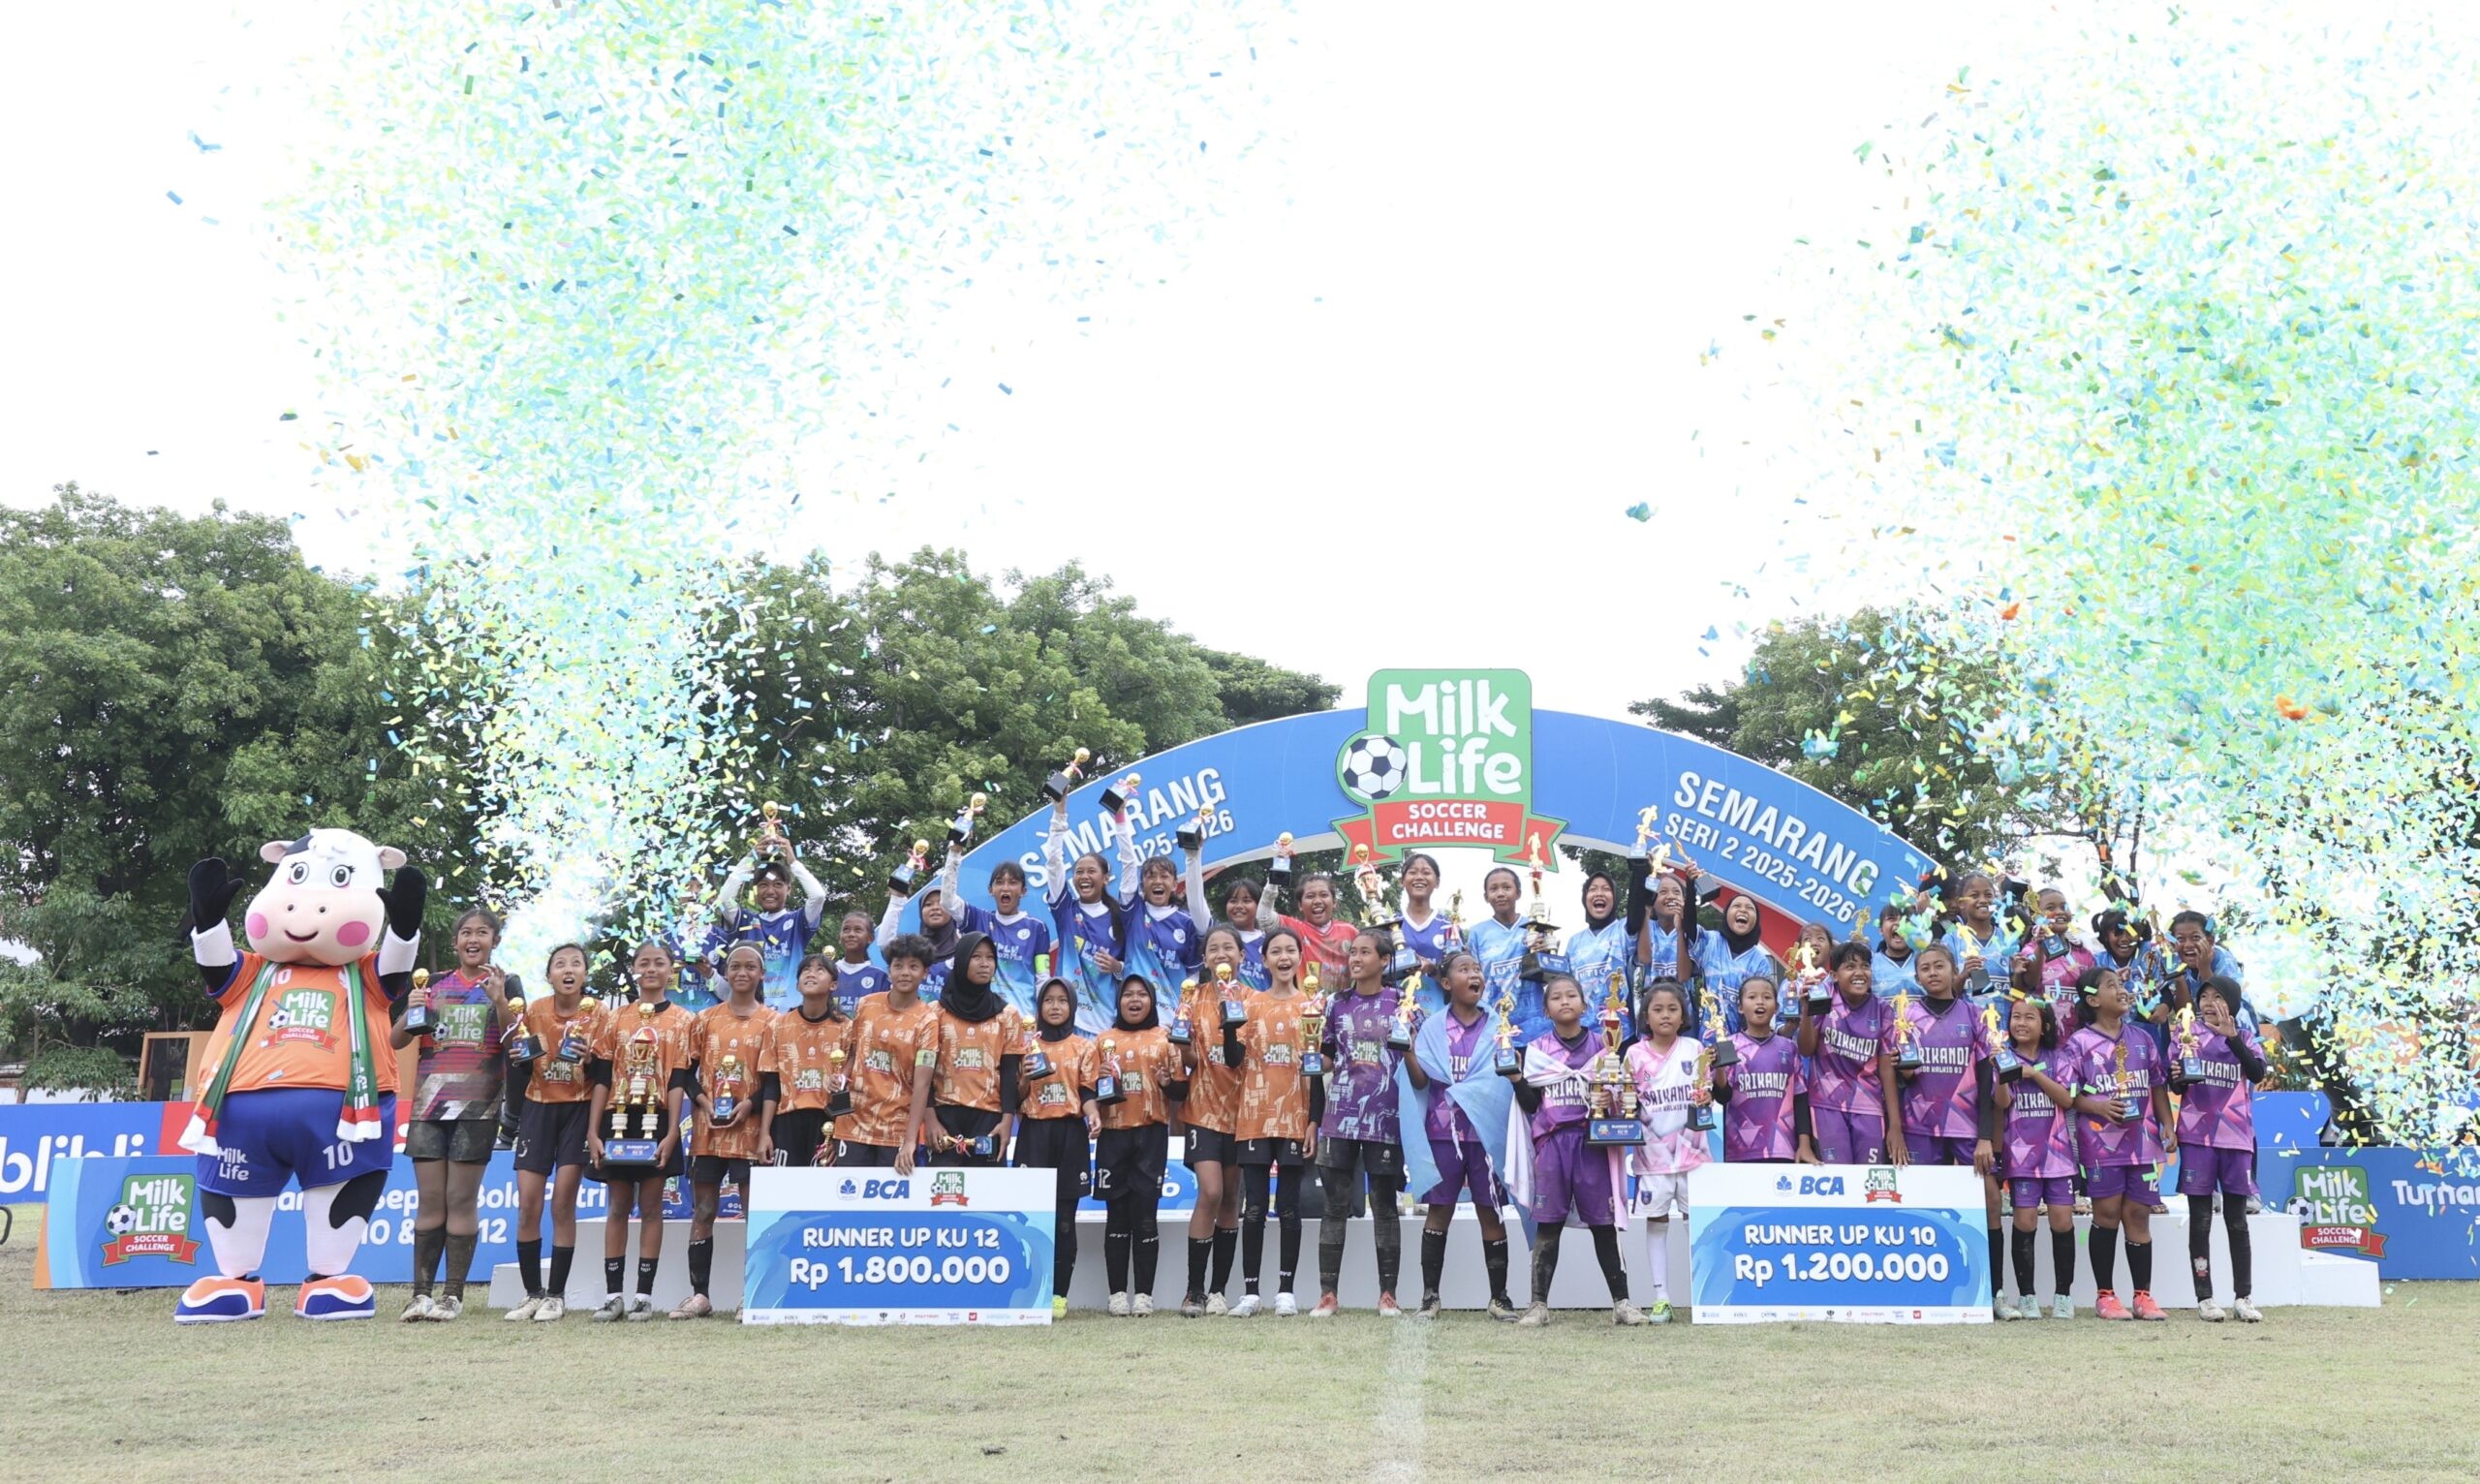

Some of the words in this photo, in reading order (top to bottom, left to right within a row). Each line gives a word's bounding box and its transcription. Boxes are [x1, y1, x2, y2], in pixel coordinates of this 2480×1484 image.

[1386, 679, 1517, 738] Milk
[1408, 737, 1522, 794] Life
[1409, 803, 1487, 819] SOCCER
[1392, 821, 1504, 840] CHALLENGE
[1673, 771, 1881, 899] SEMARANG
[1664, 812, 1721, 852] SERI
[1721, 837, 1741, 860] 2
[1741, 846, 1858, 924] 2025-2026
[285, 991, 328, 1011] Milk
[288, 1009, 328, 1028] Life
[444, 1007, 481, 1023] Milk
[281, 1033, 320, 1041] CHALLENGE
[449, 1023, 481, 1039] Life
[1270, 1044, 1289, 1054] Milk
[1357, 1042, 1377, 1052] Milk
[1823, 1027, 1878, 1057] SRIKANDI
[872, 1050, 890, 1063] Milk
[960, 1049, 981, 1060] Milk
[962, 1058, 981, 1067] Life
[1272, 1053, 1290, 1063] Life
[1358, 1051, 1378, 1062] Life
[1918, 1047, 1969, 1067] RIKANDI
[801, 1069, 822, 1080] Milk
[873, 1060, 890, 1071] Life
[2201, 1060, 2242, 1081] IKANDI
[805, 1079, 822, 1089] Life
[1044, 1084, 1064, 1094] Milk
[1544, 1079, 1582, 1098] SRIKA
[1047, 1093, 1066, 1103] Life
[1643, 1084, 1691, 1106] SRIKAND
[2015, 1092, 2054, 1110] RIKAN
[1190, 1129, 1197, 1150] 3
[217, 1147, 248, 1163] Milk
[322, 1140, 354, 1170] 10
[219, 1163, 249, 1181] Life
[939, 1173, 962, 1184] Milk
[1098, 1168, 1111, 1189] 12
[1872, 1170, 1894, 1181] Milk
[129, 1178, 187, 1206] Milk
[862, 1179, 910, 1199] BCA
[942, 1183, 963, 1194] Life
[1799, 1175, 1844, 1196] BCA
[1875, 1180, 1896, 1190] Life
[2303, 1169, 2363, 1198] Milk
[2391, 1180, 2480, 1205] Turna
[135, 1205, 186, 1231] Life
[2314, 1197, 2367, 1224] Life
[397, 1218, 415, 1245] &
[478, 1218, 508, 1244] 12
[803, 1227, 894, 1248] RUNNER
[901, 1227, 931, 1248] UP
[937, 1228, 968, 1248] KU
[974, 1228, 1000, 1249] 12
[1745, 1224, 1834, 1245] RUNNER
[1841, 1225, 1870, 1245] UP
[1876, 1225, 1905, 1246] KU
[1910, 1225, 1937, 1246] 10
[790, 1256, 829, 1290] Rp
[837, 1255, 1010, 1284] 1.800.000
[1735, 1253, 1773, 1287] Rp
[1781, 1252, 1949, 1282] 1.200.000
